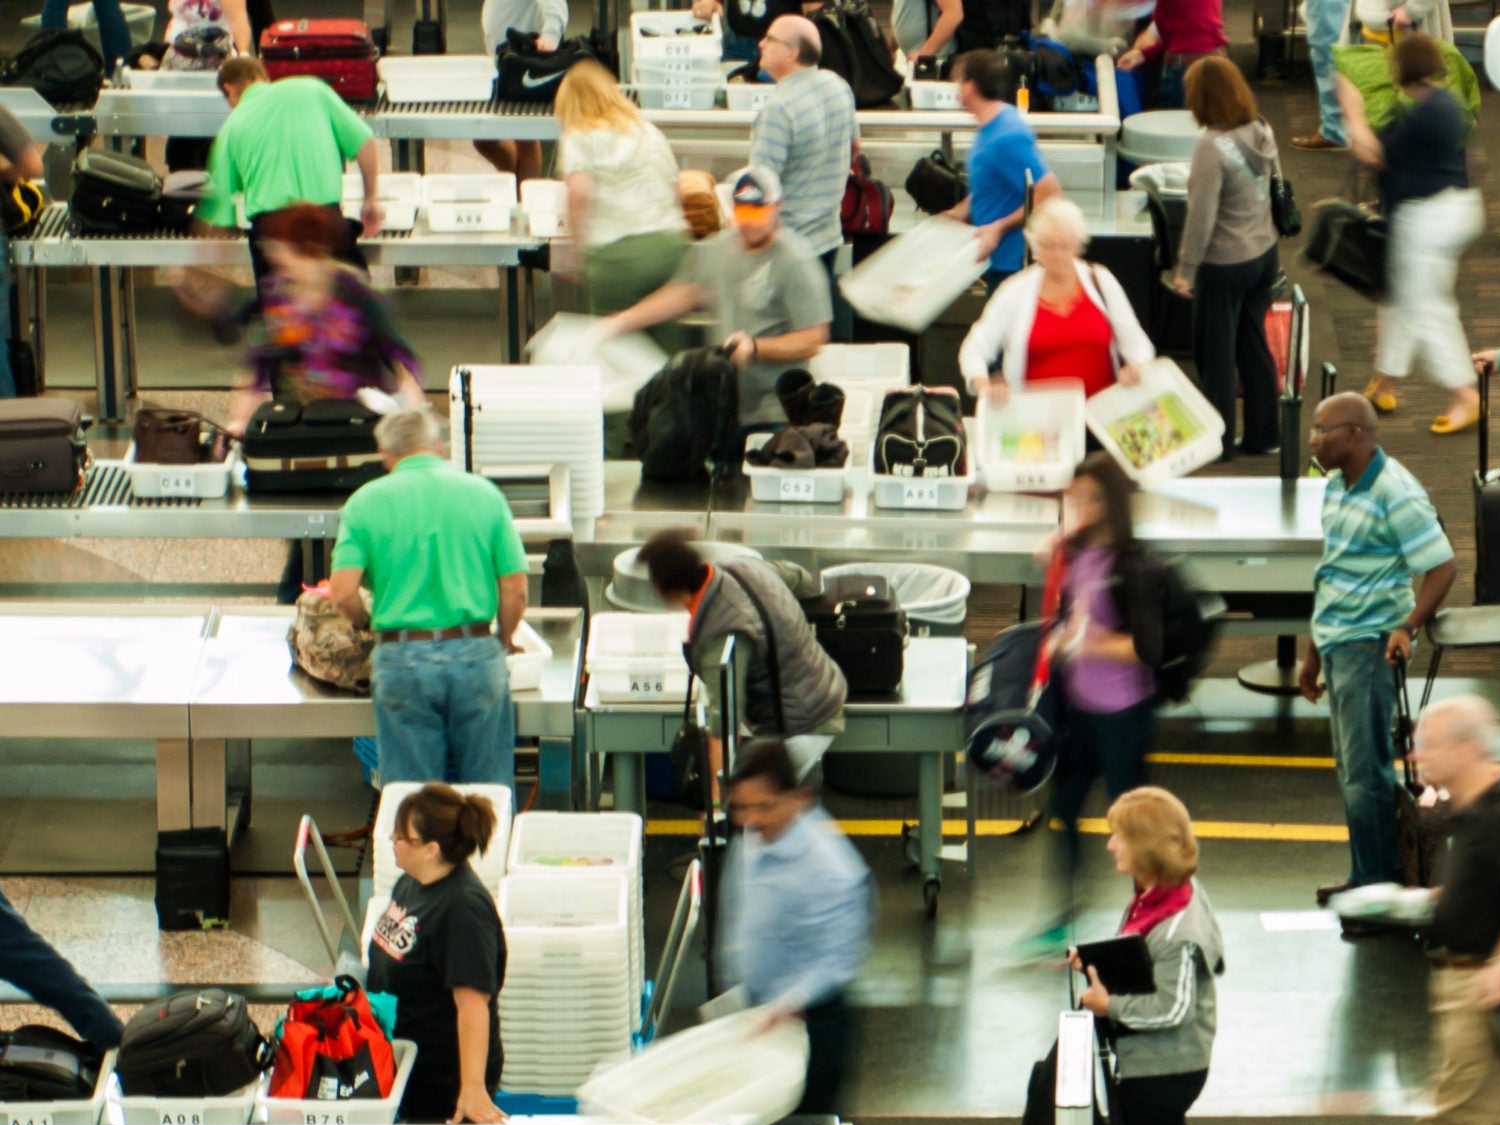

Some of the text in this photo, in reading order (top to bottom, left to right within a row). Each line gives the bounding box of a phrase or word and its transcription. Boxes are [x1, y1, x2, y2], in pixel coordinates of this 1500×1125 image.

[631, 681, 664, 692] A56
[161, 1113, 201, 1125] A08
[306, 1114, 345, 1125] B76
